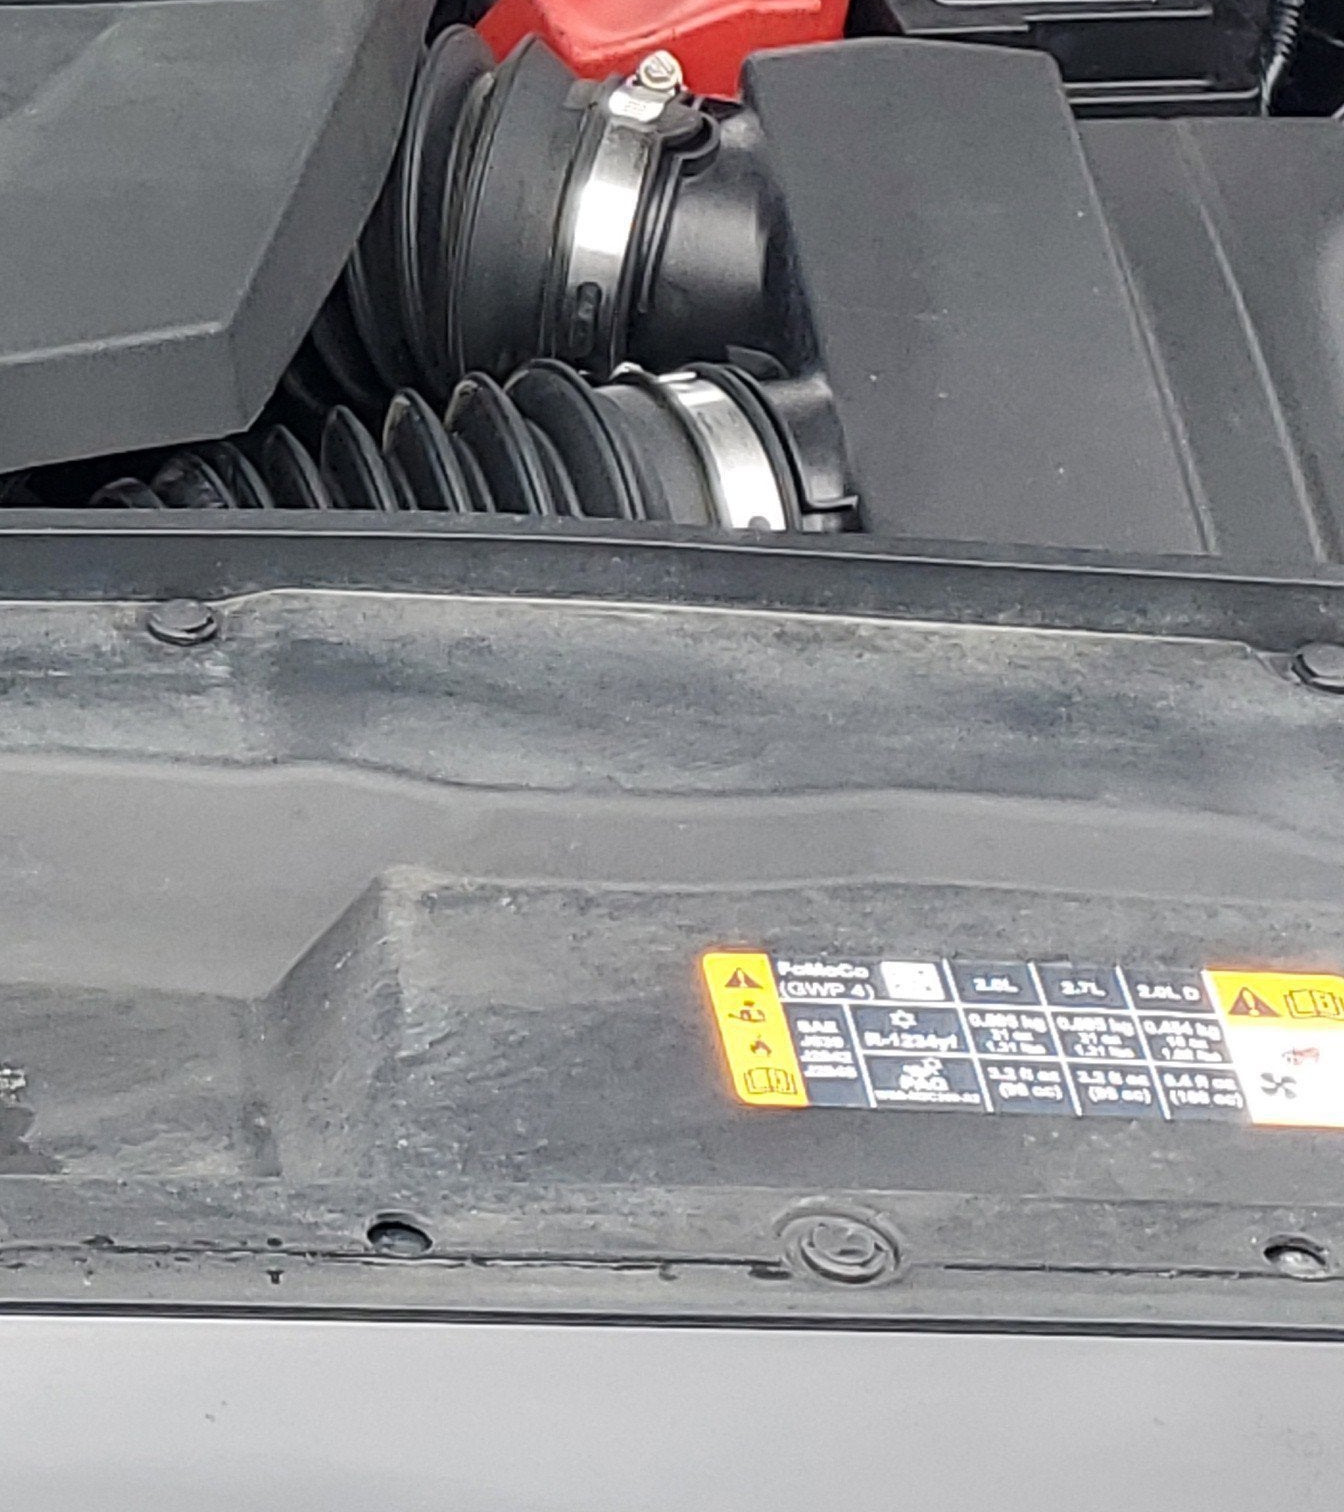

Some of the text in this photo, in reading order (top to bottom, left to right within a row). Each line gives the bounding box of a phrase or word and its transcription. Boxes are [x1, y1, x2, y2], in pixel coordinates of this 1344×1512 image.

[779, 980, 876, 1001] (GWP 4)
[864, 1031, 958, 1052] R-1234yf
